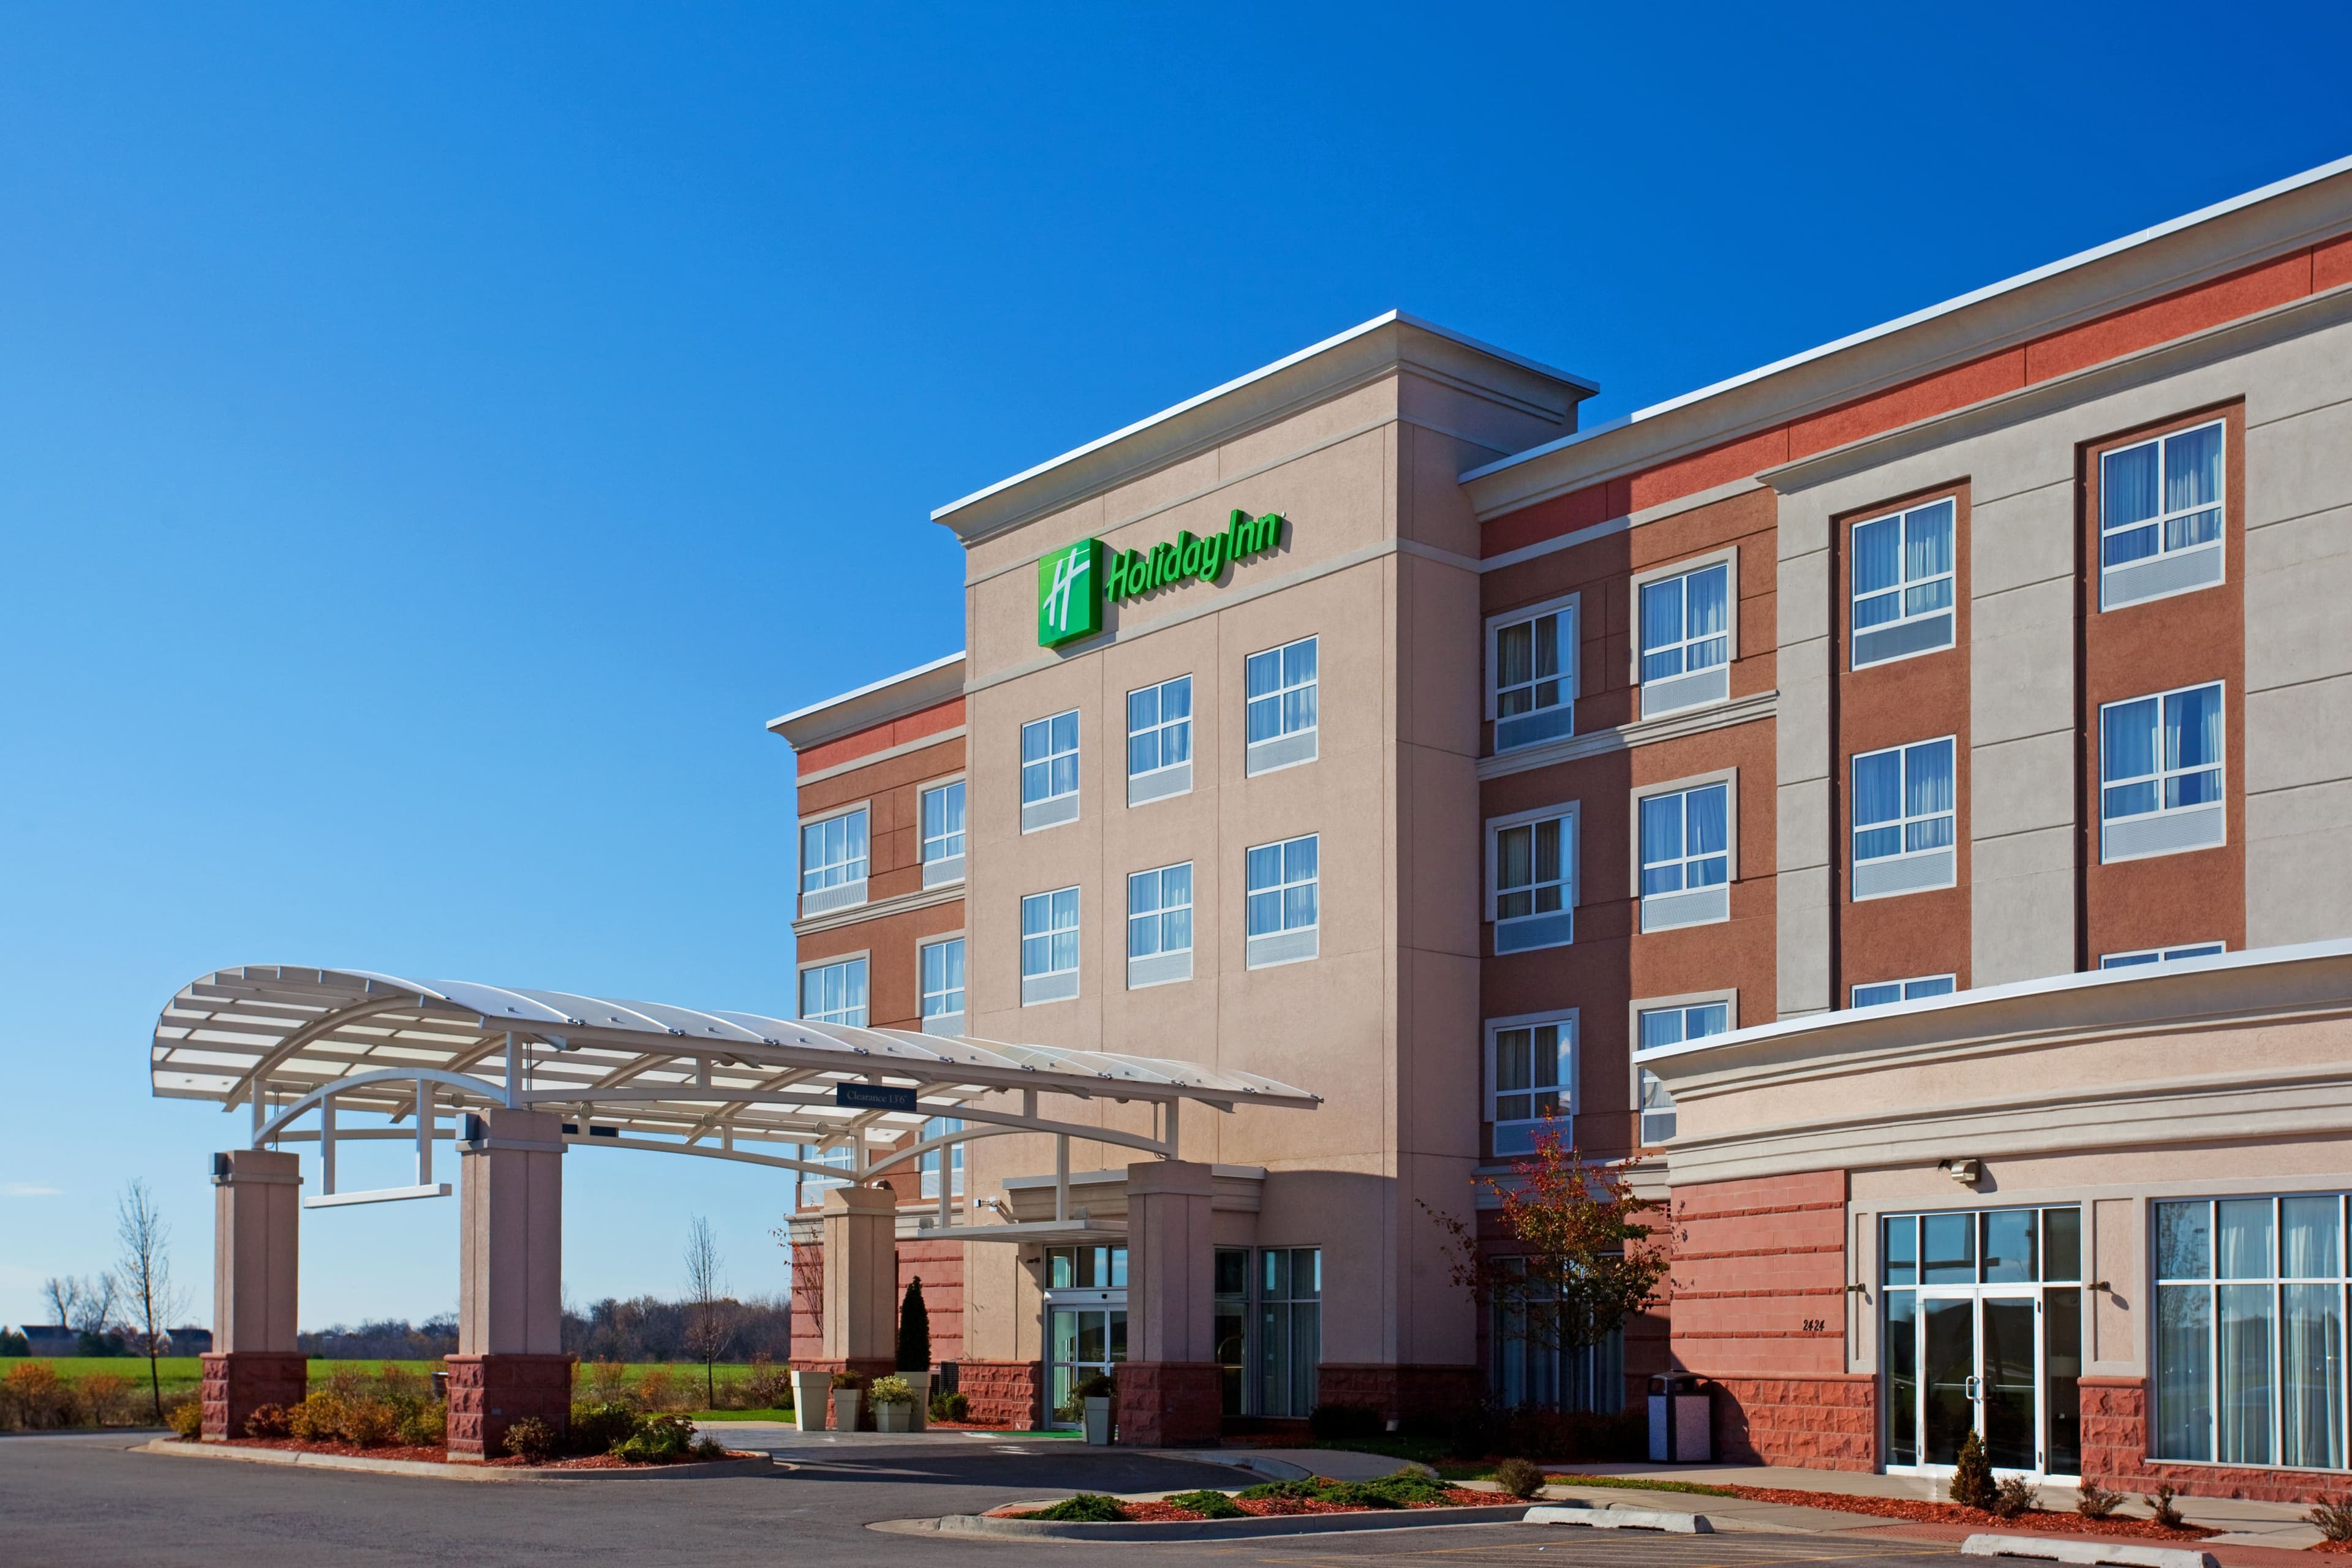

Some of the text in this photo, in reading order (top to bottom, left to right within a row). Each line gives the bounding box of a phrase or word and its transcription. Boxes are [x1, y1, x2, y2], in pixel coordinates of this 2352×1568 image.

[1106, 509, 1282, 602] Holiday Inn
[1043, 548, 1090, 631] H
[847, 1090, 887, 1102] Clearance
[1803, 1319, 1825, 1331] 2424
